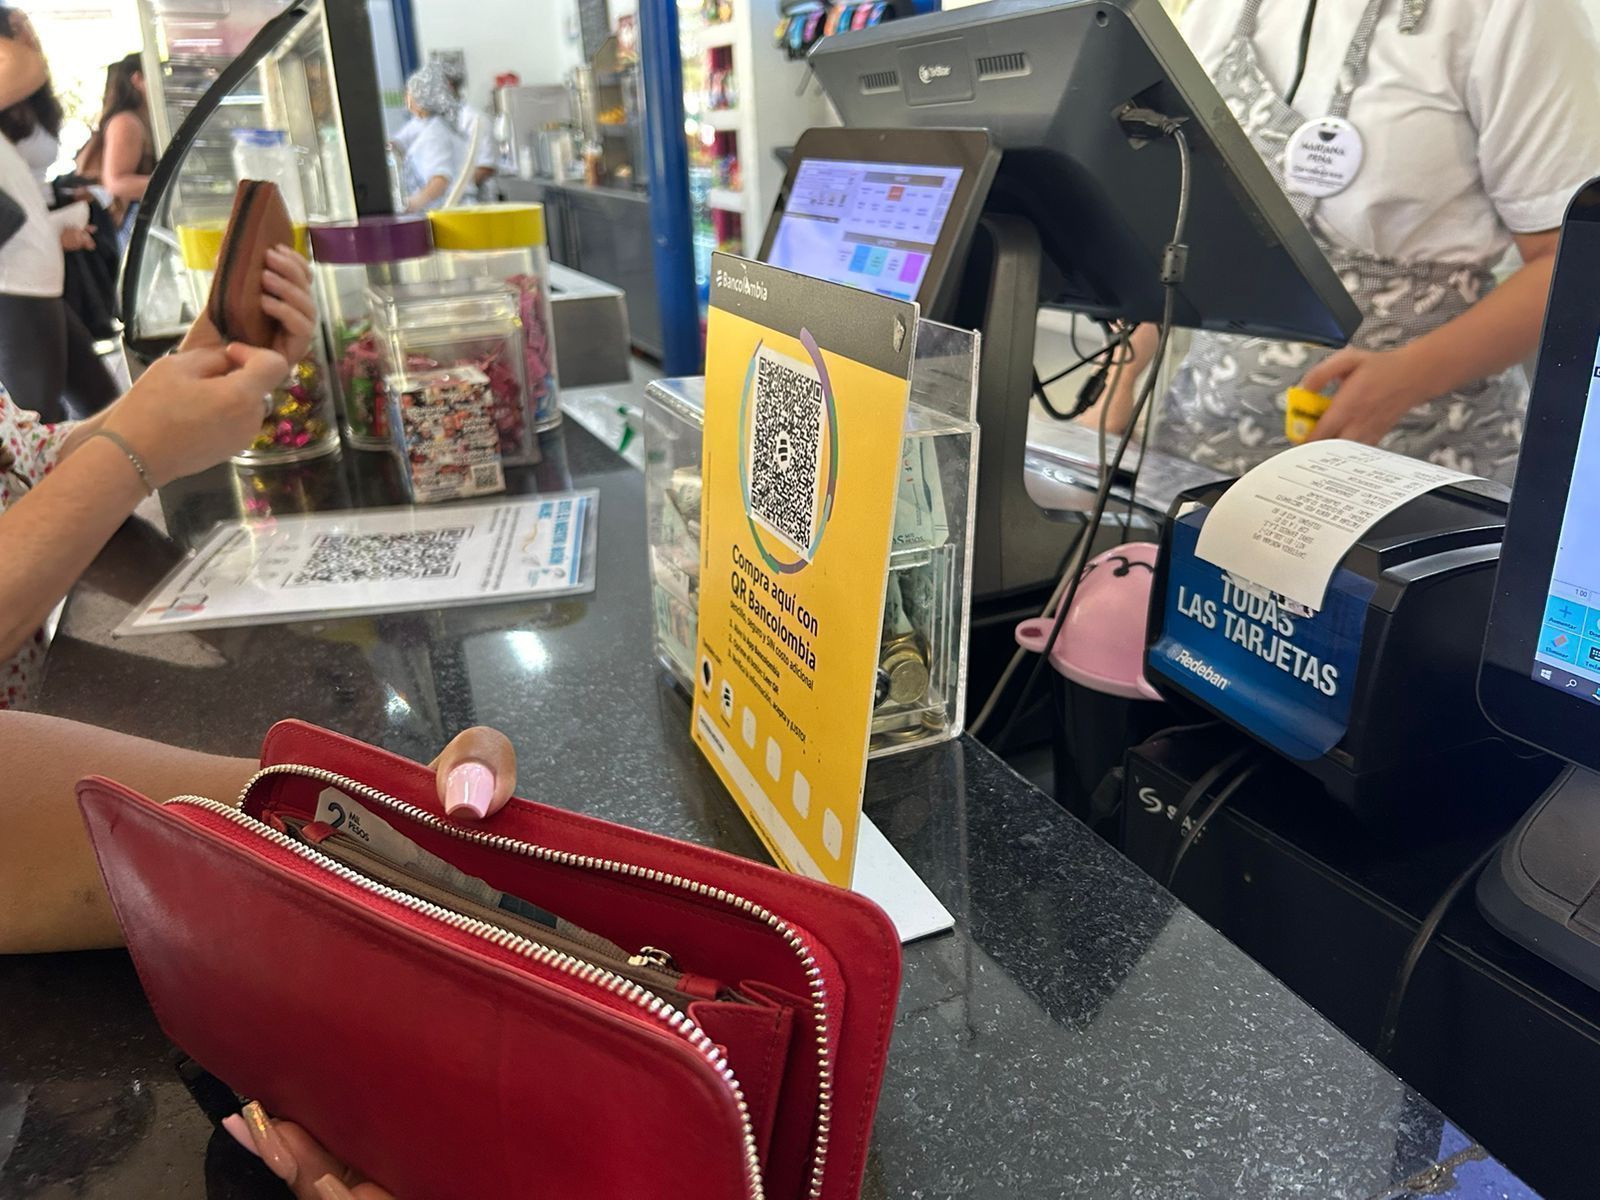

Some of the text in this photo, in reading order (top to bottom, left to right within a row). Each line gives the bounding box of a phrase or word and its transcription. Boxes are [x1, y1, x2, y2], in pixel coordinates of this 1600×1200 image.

[723, 271, 768, 302] Bancolombia
[731, 571, 746, 604] QR
[748, 588, 816, 672] Bancolombia
[732, 544, 818, 638] Compra aquí con
[1221, 574, 1295, 637] TODAS
[1175, 650, 1227, 691] Redeban
[1177, 585, 1339, 697] LAS TARJETAS
[789, 660, 814, 692] adicional
